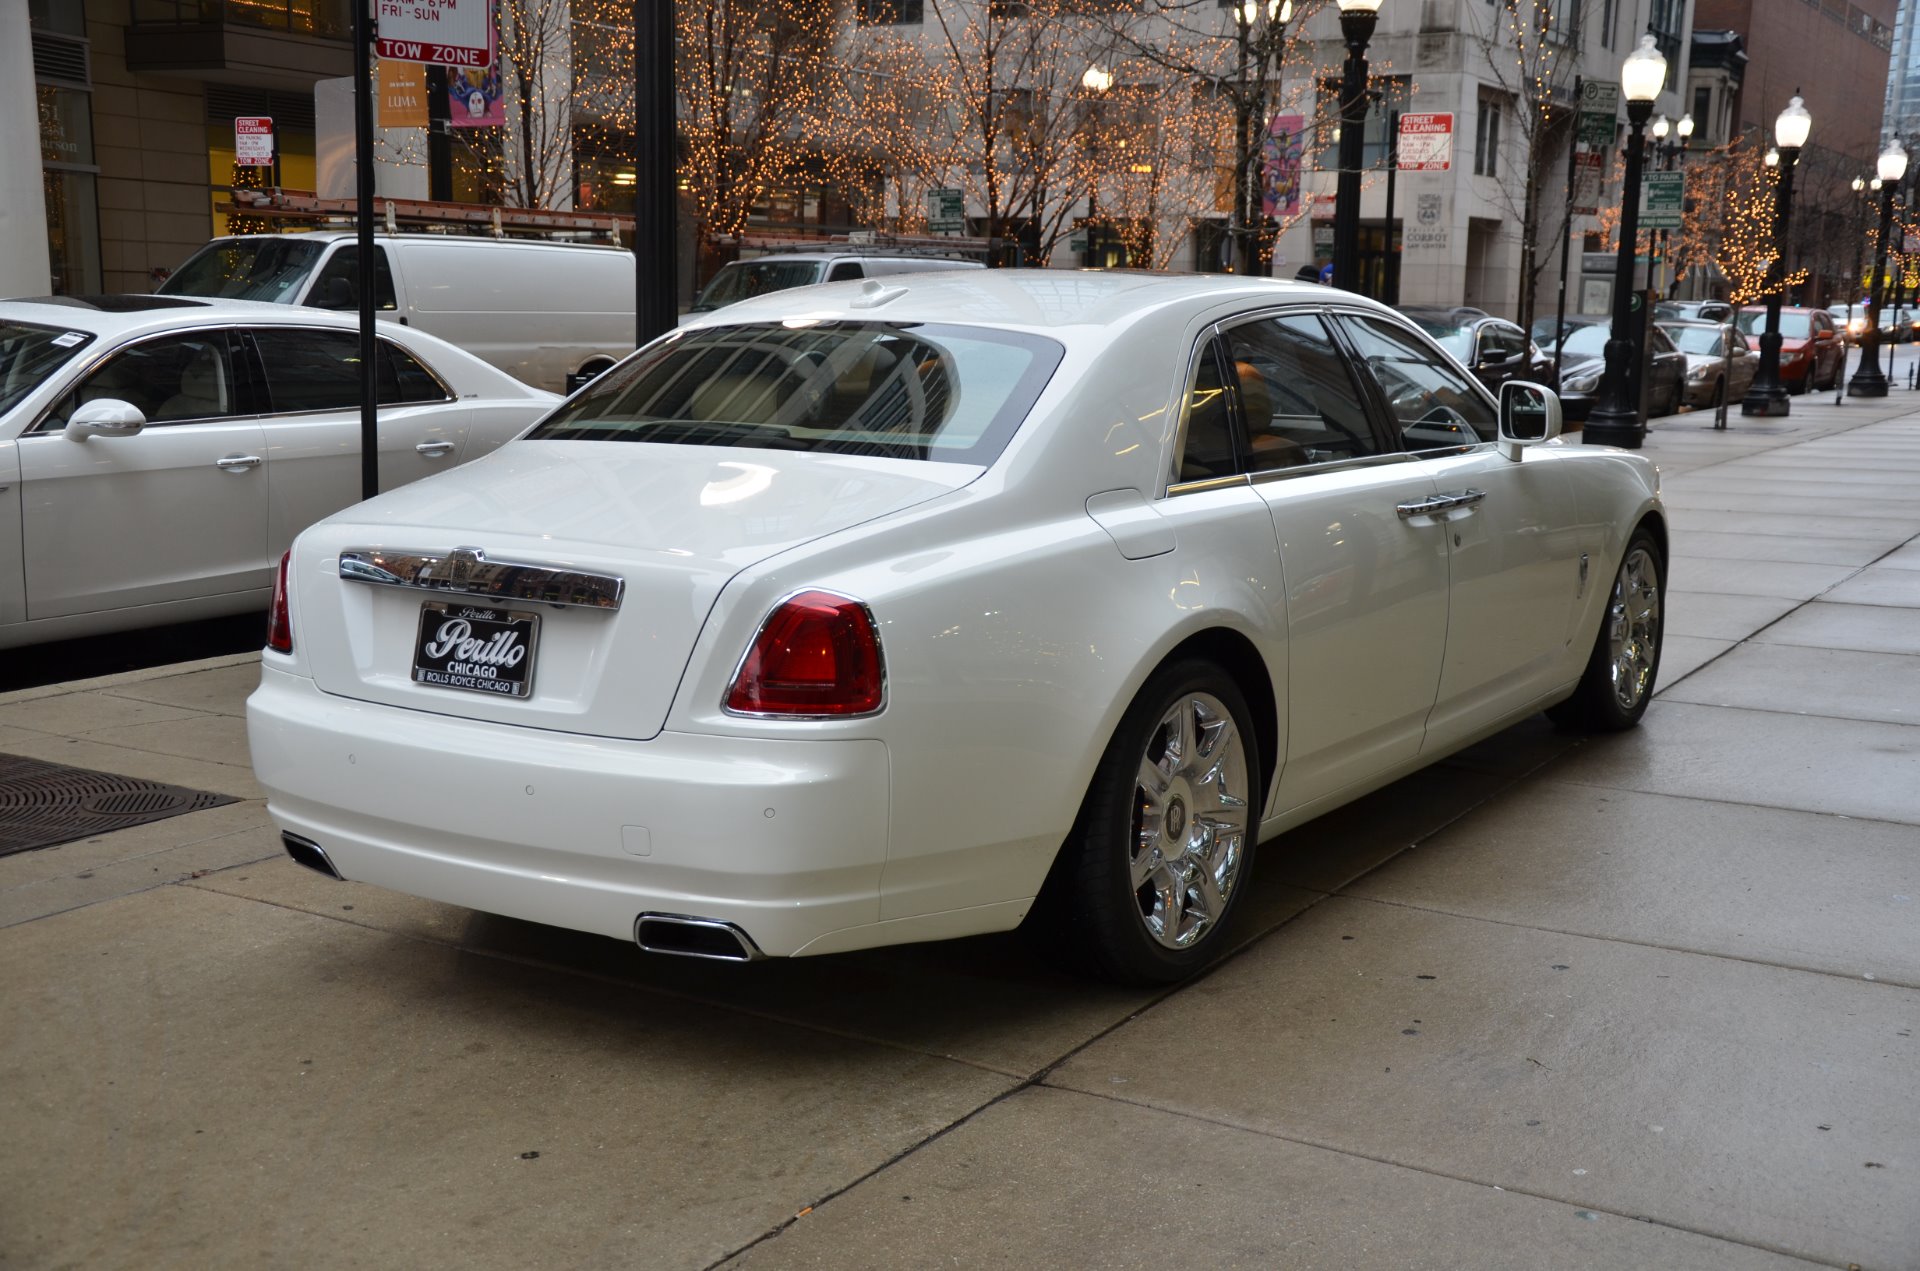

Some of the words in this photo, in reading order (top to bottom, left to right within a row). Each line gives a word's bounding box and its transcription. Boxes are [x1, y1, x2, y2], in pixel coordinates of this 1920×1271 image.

[439, 0, 457, 10] PM
[382, 4, 402, 17] FRI
[414, 7, 440, 21] SUN
[383, 41, 422, 59] TOW
[432, 46, 480, 65] ZONE
[388, 95, 417, 108] LUMA
[1403, 116, 1435, 124] STREET
[1403, 123, 1447, 132] CLEANING
[1402, 162, 1418, 170] TOW
[1423, 161, 1444, 170] ZONE
[459, 607, 496, 620] Perillo
[425, 618, 526, 669] Perillo
[447, 661, 497, 679] CHICAGO
[426, 671, 449, 684] ROLLS
[450, 676, 475, 688] ROYCE
[477, 679, 510, 692] CHICAGO
